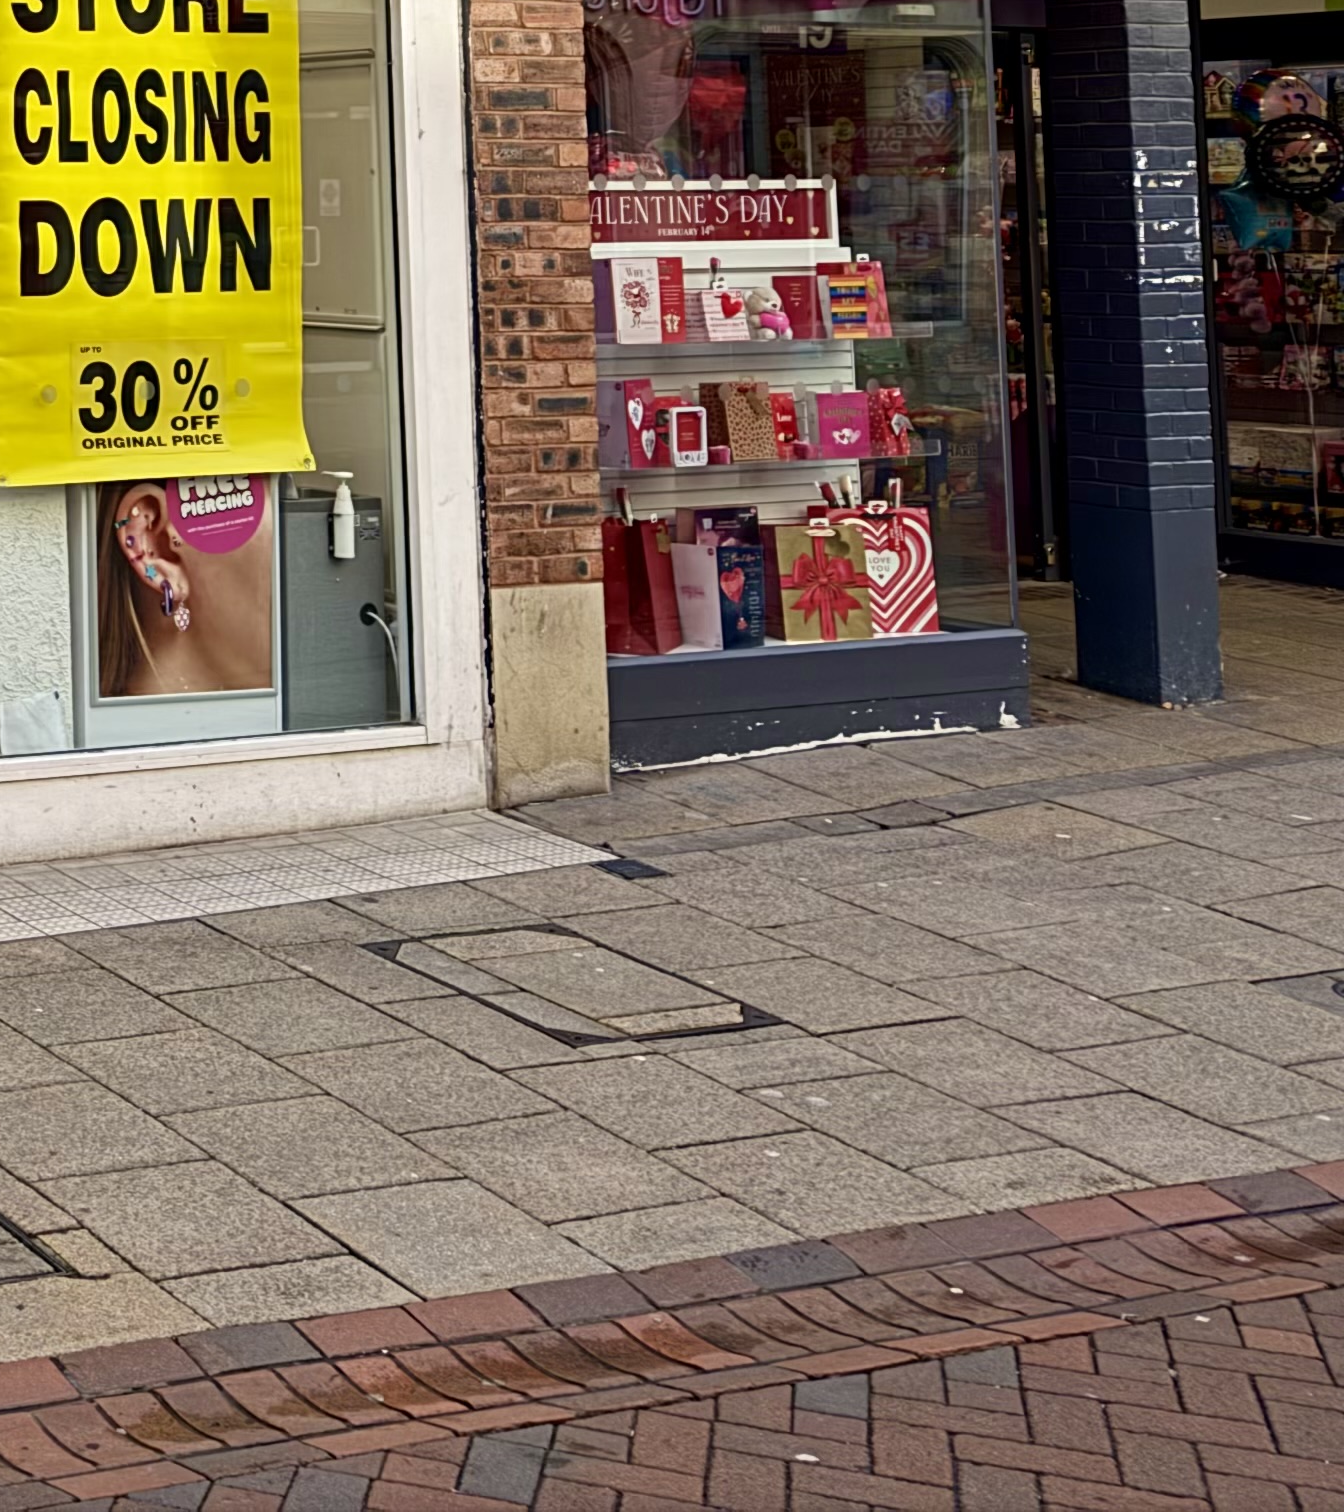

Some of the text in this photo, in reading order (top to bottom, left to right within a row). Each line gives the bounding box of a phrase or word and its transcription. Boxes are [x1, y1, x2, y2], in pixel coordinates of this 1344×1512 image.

[13, 67, 271, 166] CLOSING
[589, 193, 788, 225] ALENTINE'S DAY
[657, 227, 699, 237] FEBRUARY
[18, 196, 273, 298] DOWN
[170, 414, 221, 431] OFF
[81, 433, 225, 450] ORIGINAL PRICE
[180, 490, 255, 519] PIERCING
[868, 556, 892, 565] LOVE
[870, 564, 891, 573] YOU
